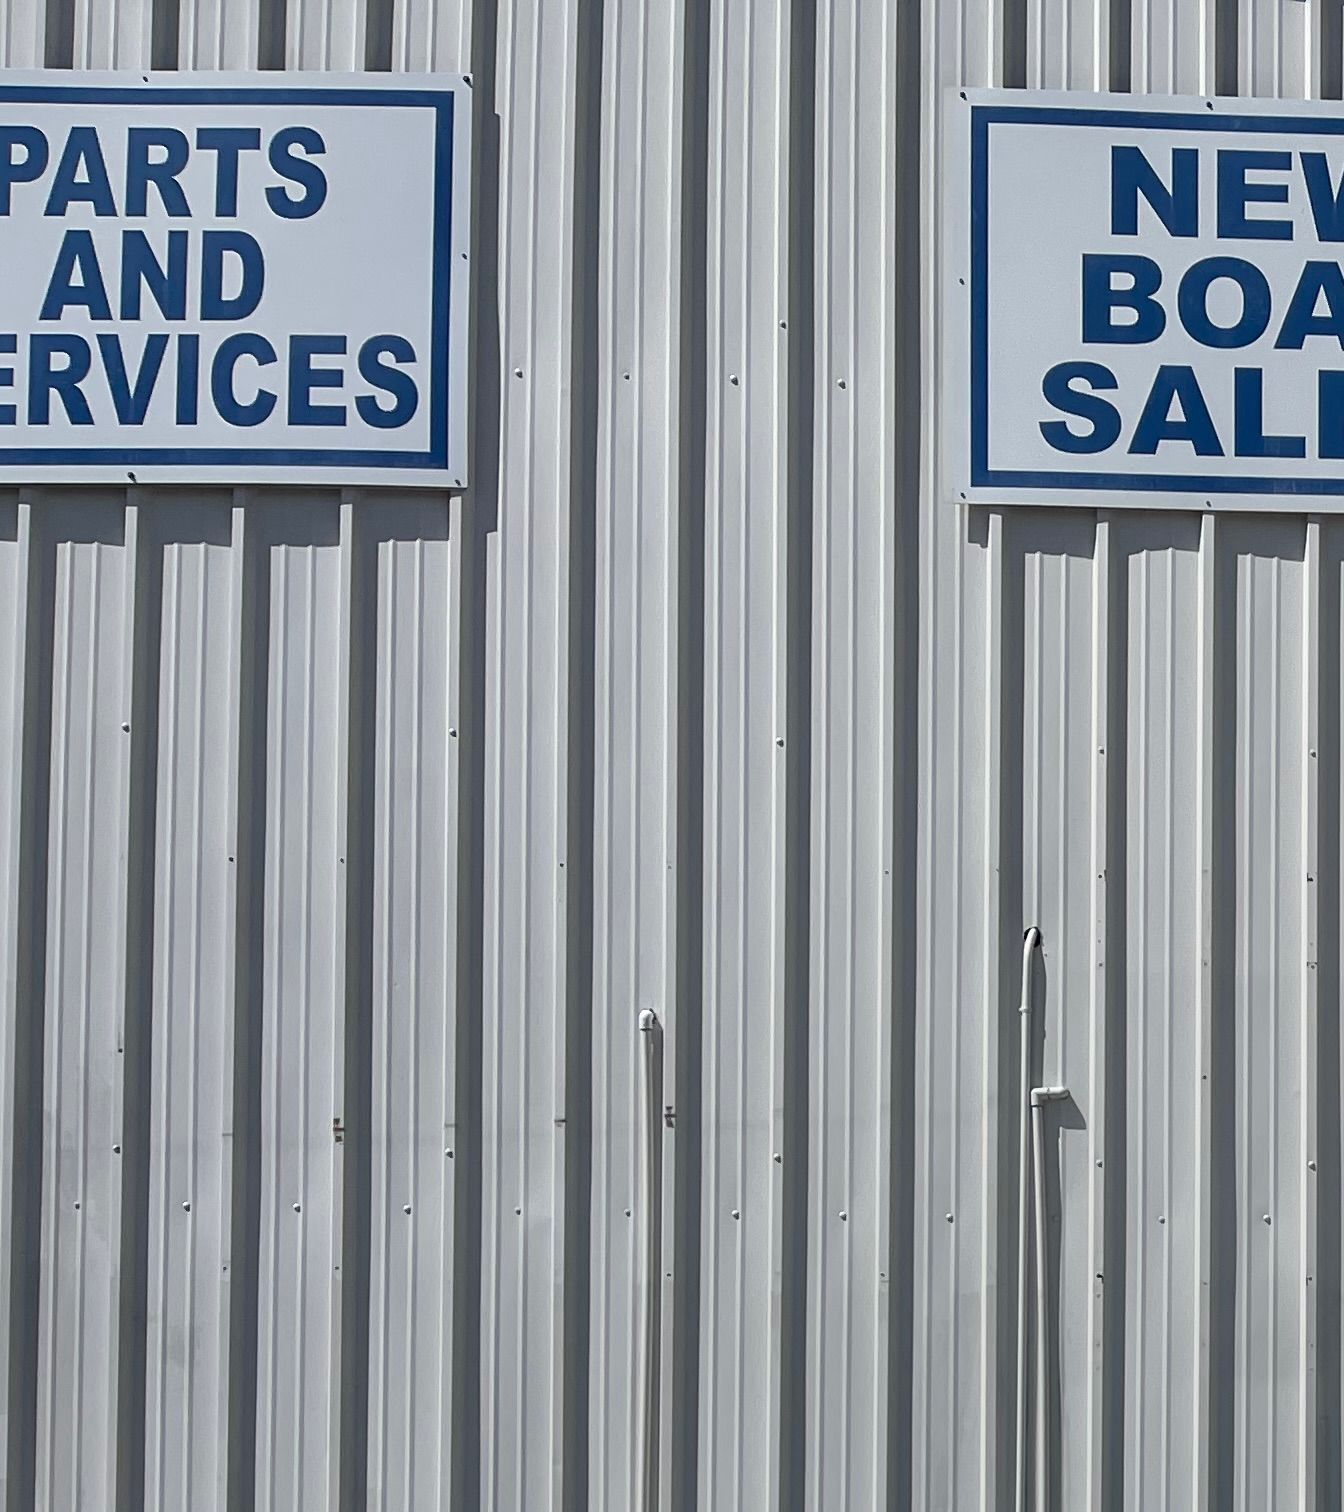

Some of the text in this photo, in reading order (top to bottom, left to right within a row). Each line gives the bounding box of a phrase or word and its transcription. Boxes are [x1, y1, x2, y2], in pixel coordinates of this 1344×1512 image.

[0, 125, 328, 220] PARTS
[38, 229, 265, 321] AND
[0, 332, 419, 430] RVICES
